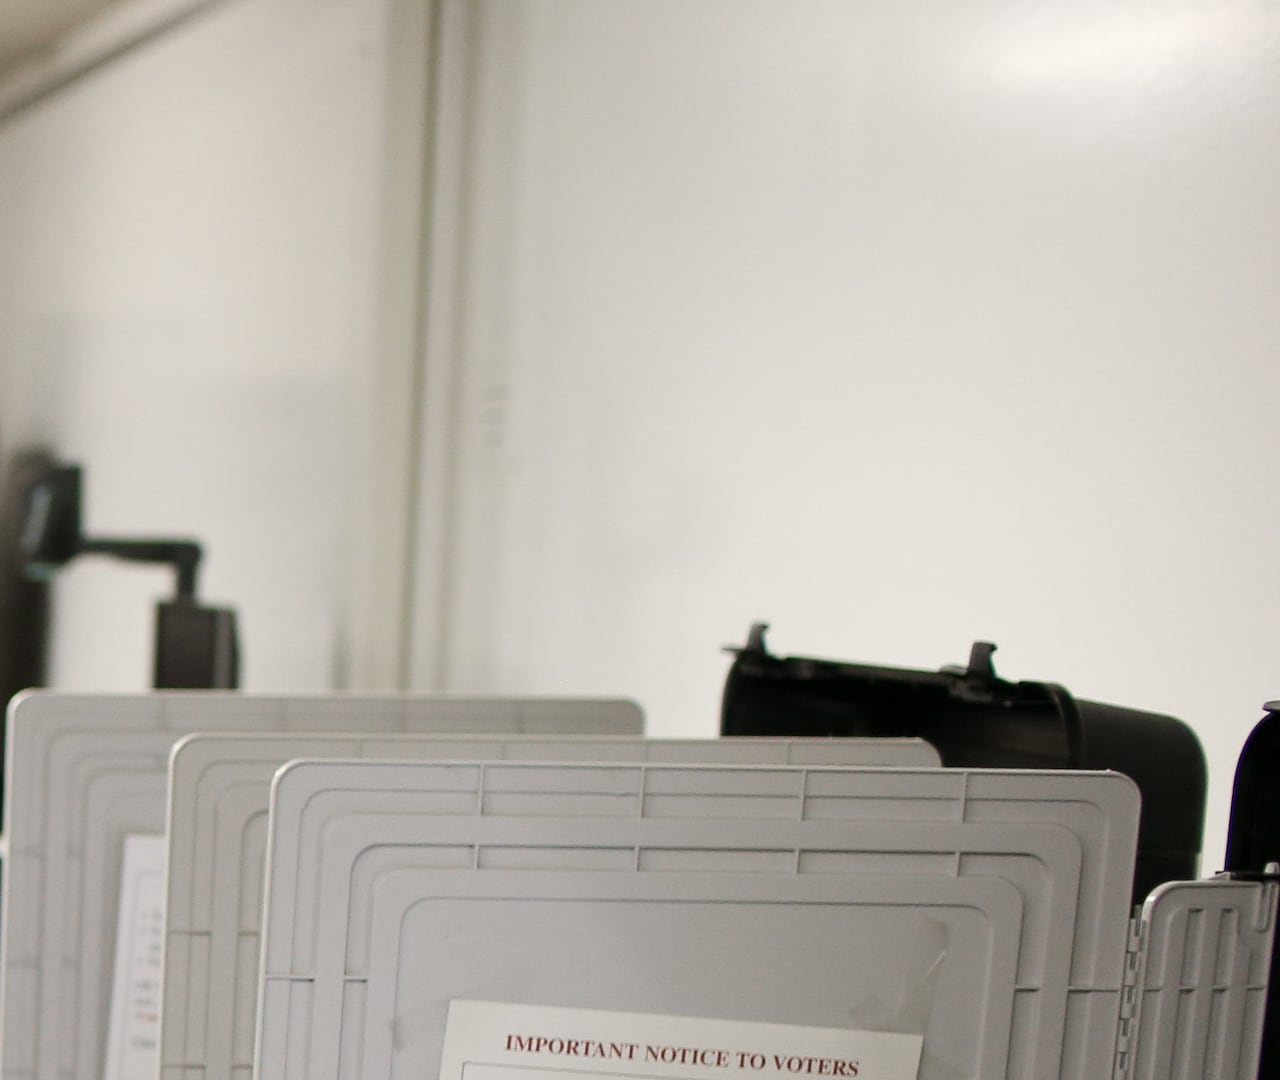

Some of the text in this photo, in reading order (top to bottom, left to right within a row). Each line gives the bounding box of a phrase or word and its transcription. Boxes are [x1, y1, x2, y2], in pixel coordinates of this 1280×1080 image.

[505, 1034, 859, 1078] IMPORTANT NOTICE TO VOTERS
